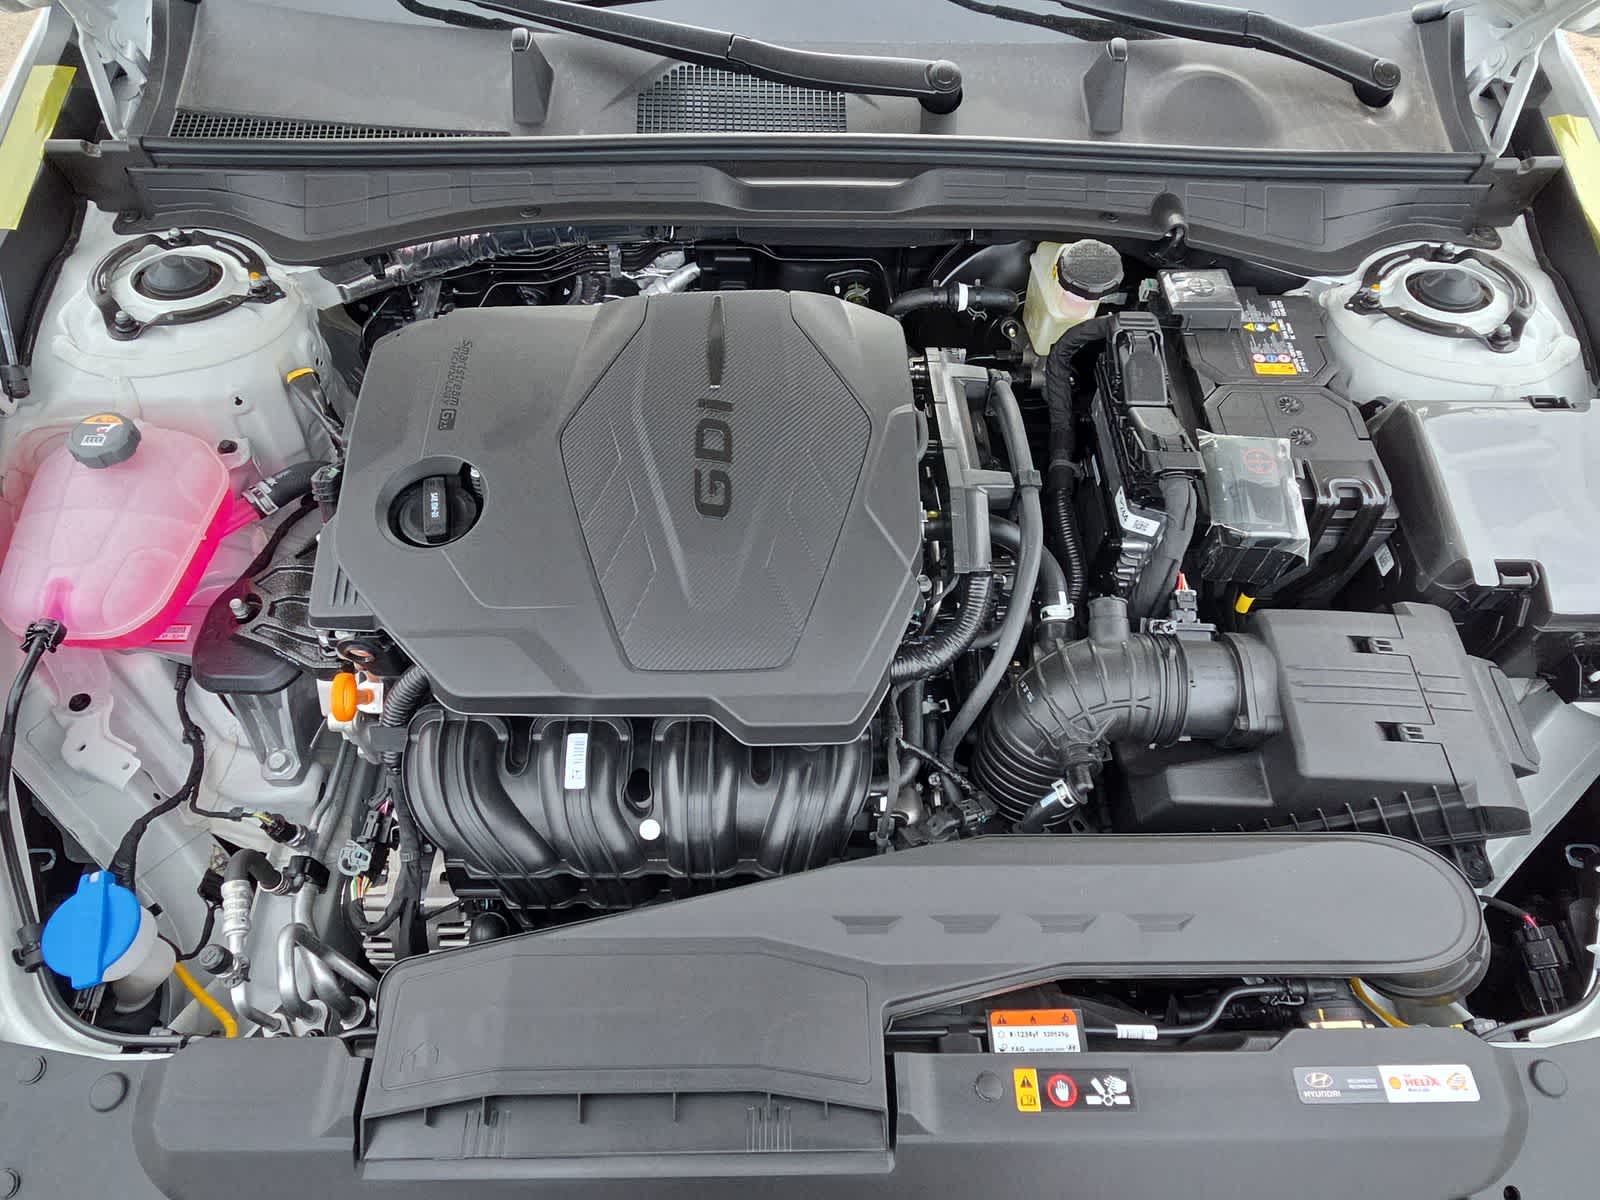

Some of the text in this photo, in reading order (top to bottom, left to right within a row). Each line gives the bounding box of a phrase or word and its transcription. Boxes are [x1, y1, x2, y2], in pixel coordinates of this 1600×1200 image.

[449, 339, 473, 407] Smartstream
[1403, 1077, 1441, 1087] HELIX
[1303, 1090, 1342, 1098] HYUNDAI
